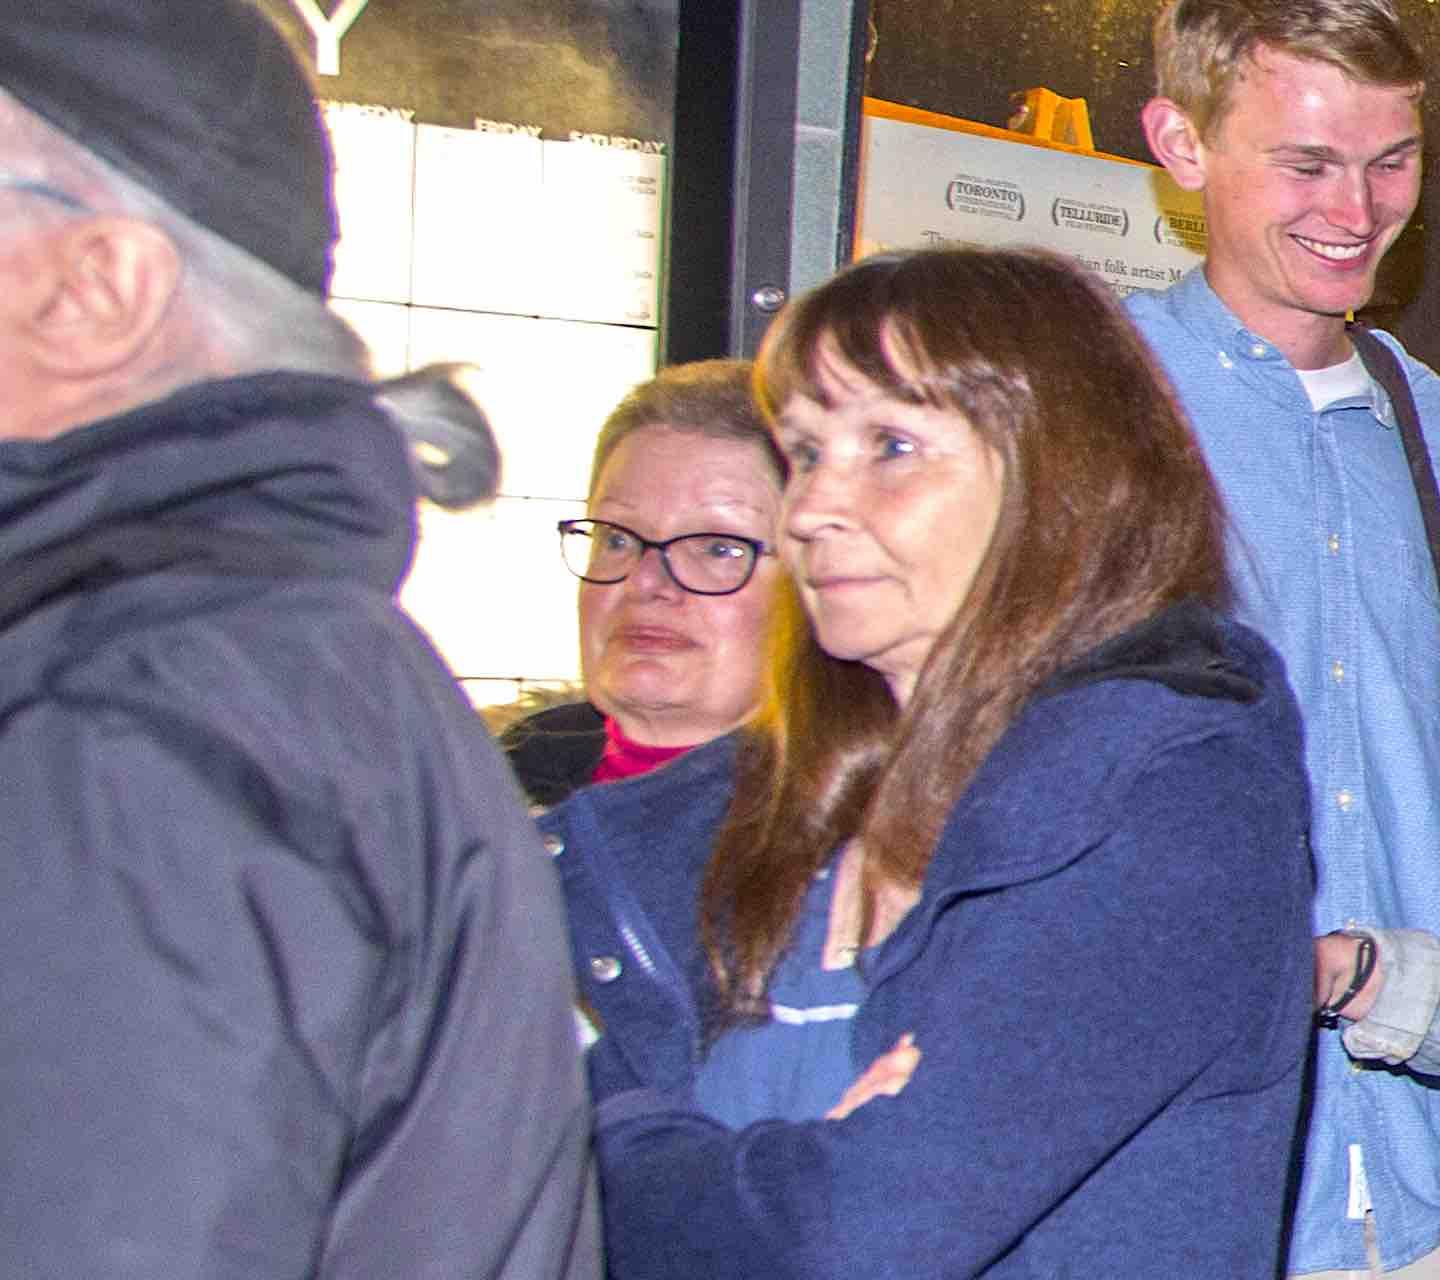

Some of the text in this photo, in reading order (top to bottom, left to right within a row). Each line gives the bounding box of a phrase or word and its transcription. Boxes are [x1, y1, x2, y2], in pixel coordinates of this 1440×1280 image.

[956, 181, 1018, 203] TORONTO
[1060, 206, 1122, 227] TELLURIDE
[1131, 265, 1166, 281] artist
